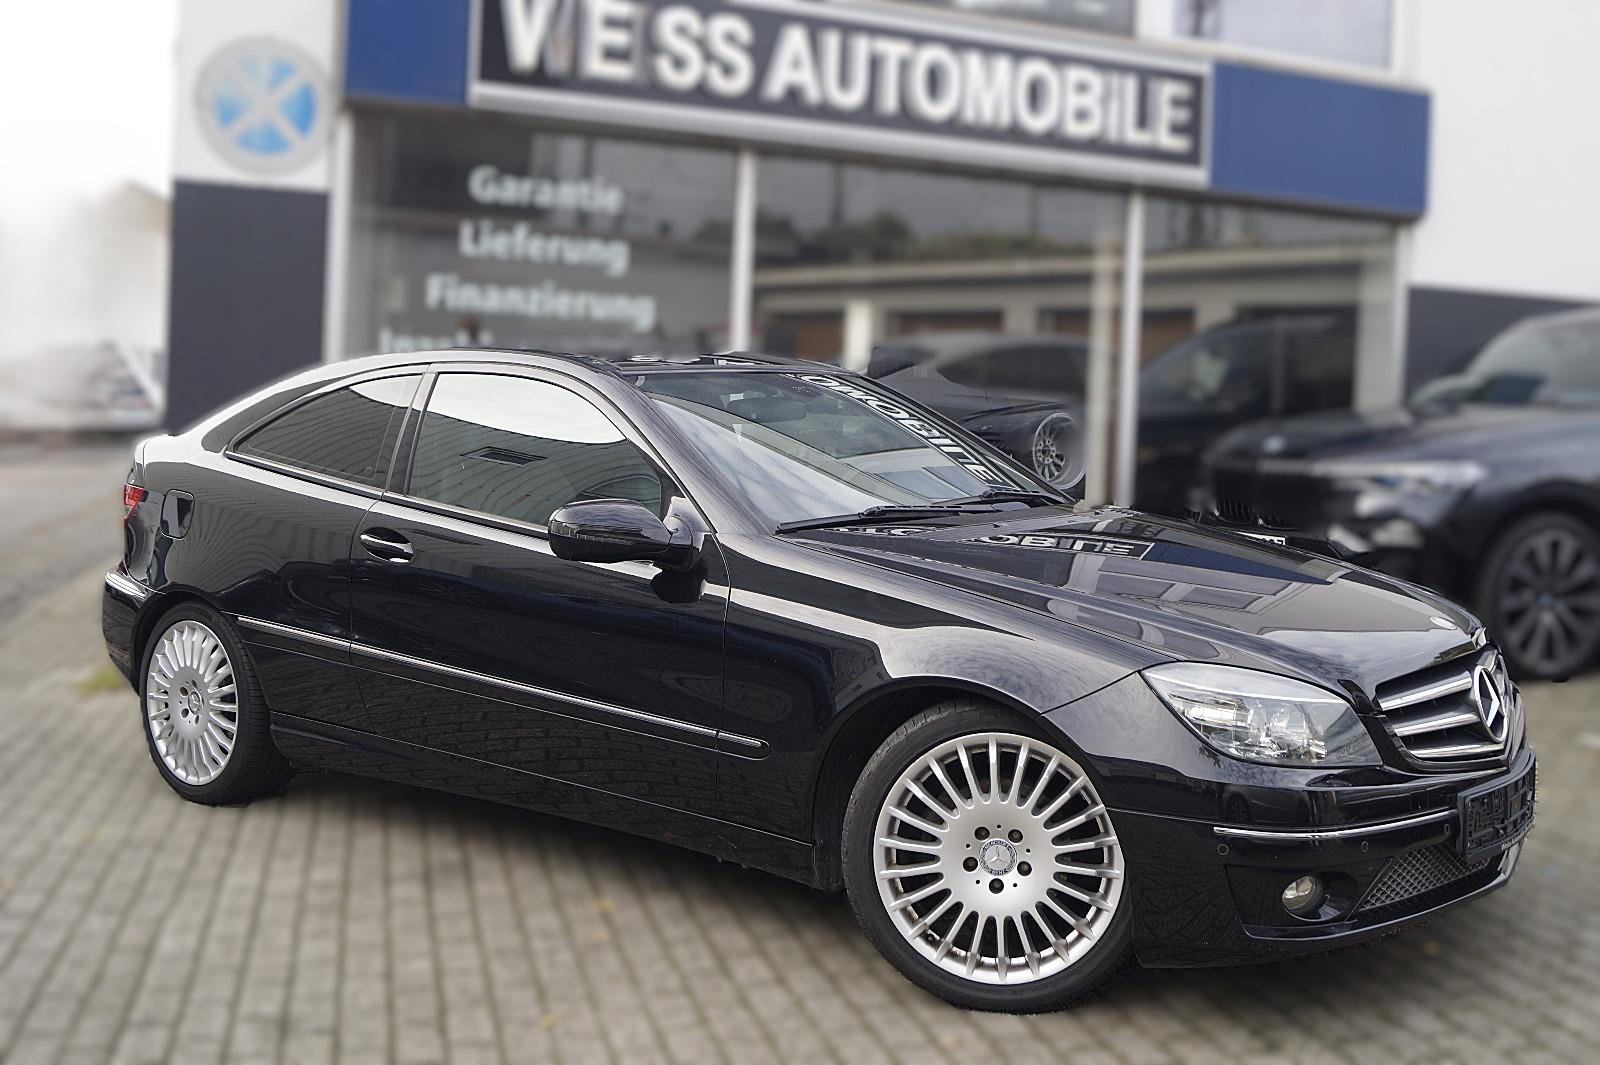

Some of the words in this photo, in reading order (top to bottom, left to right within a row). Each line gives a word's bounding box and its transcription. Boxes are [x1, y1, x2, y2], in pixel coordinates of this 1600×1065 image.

[502, 0, 754, 97] WESS
[763, 24, 1193, 152] AUTOMOBILE
[469, 165, 623, 215] Garantie
[459, 218, 630, 277] Lieferung
[425, 272, 655, 332] Finanzierung
